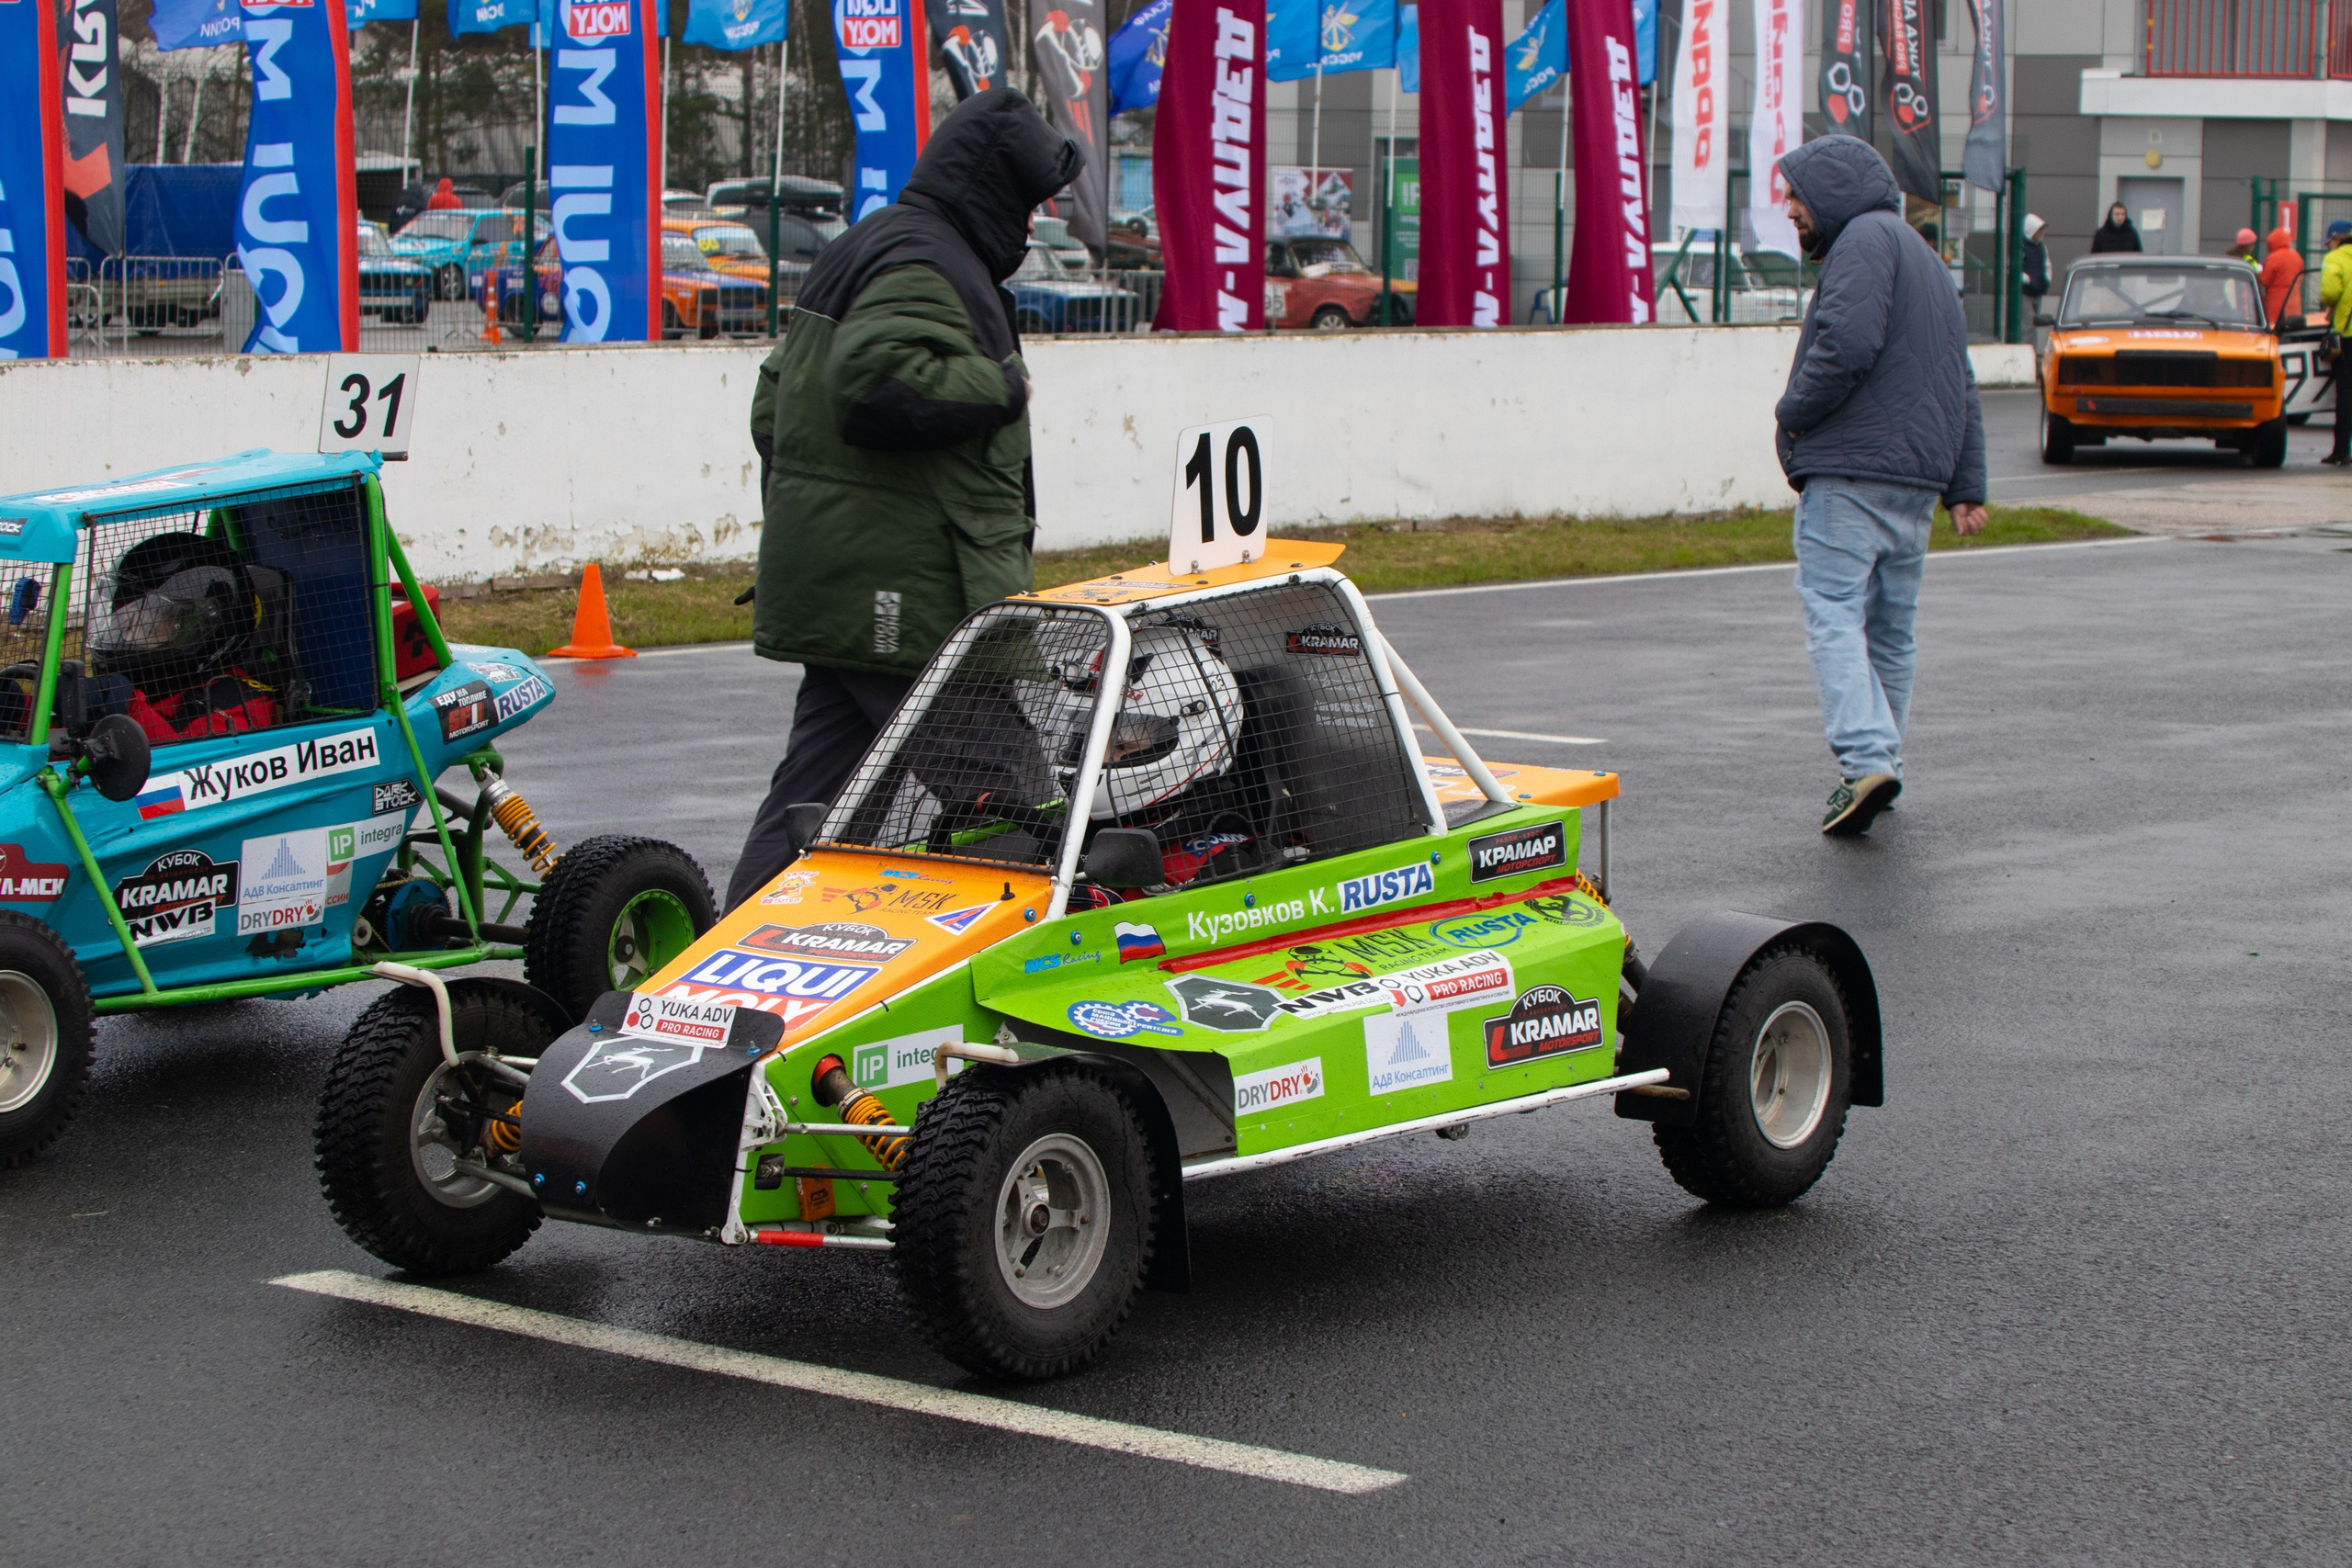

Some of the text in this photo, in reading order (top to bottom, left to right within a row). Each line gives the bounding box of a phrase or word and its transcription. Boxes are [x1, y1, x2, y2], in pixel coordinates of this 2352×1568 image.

[334, 373, 406, 439] 31
[1184, 425, 1262, 544] 10
[0, 520, 22, 535] OCK
[1301, 635, 1360, 649] KRAMAR
[435, 688, 469, 706] ЕДУ НА
[457, 690, 488, 707] ТОПЛИВЕ
[497, 678, 547, 720] RUSTA
[448, 719, 490, 739] MOTORSPORT
[184, 735, 378, 802] Жуков Иван
[375, 781, 409, 800] DARK
[375, 791, 416, 811] STOCK
[333, 823, 403, 856] IP integra
[1478, 835, 1556, 868] КРАМАР
[157, 852, 201, 872] КУБОК
[1496, 853, 1557, 874] МОТОРСПОРТ
[120, 874, 228, 909] KRAMAR
[243, 879, 324, 899] АДВ Консалтинг
[888, 889, 960, 910] MSK
[1343, 863, 1432, 912] RUSTA
[128, 902, 214, 942] NWB
[240, 907, 304, 931] DRYDRY
[1187, 886, 1335, 944] Кузовков К.
[1446, 911, 1540, 943] RUSTA
[821, 924, 877, 936] КУБОК
[781, 932, 906, 954] KRAMAR
[1333, 928, 1437, 963] MSK
[1024, 951, 1102, 974] NCS Racing
[1378, 947, 1452, 971] RACING TEAM
[1403, 951, 1500, 982] YUKA ADV
[690, 954, 869, 998] LIQUI
[1431, 971, 1503, 998] PRO RACING
[1276, 981, 1380, 1013] NWB
[1521, 988, 1562, 1010] КУБОК
[661, 1000, 734, 1023] YUKA ADV
[1090, 1017, 1122, 1028] РОССИИ
[1092, 1008, 1116, 1017] СОЮЗ
[660, 1021, 682, 1033] PRO
[683, 1024, 720, 1039] RACING
[1510, 1007, 1599, 1045] KRAMAR
[1538, 1031, 1600, 1053] MOTORSPORT
[862, 1055, 885, 1082] IP
[1372, 1064, 1450, 1090] АДВ Консалтинг
[1238, 1073, 1301, 1110] DRYDRY
